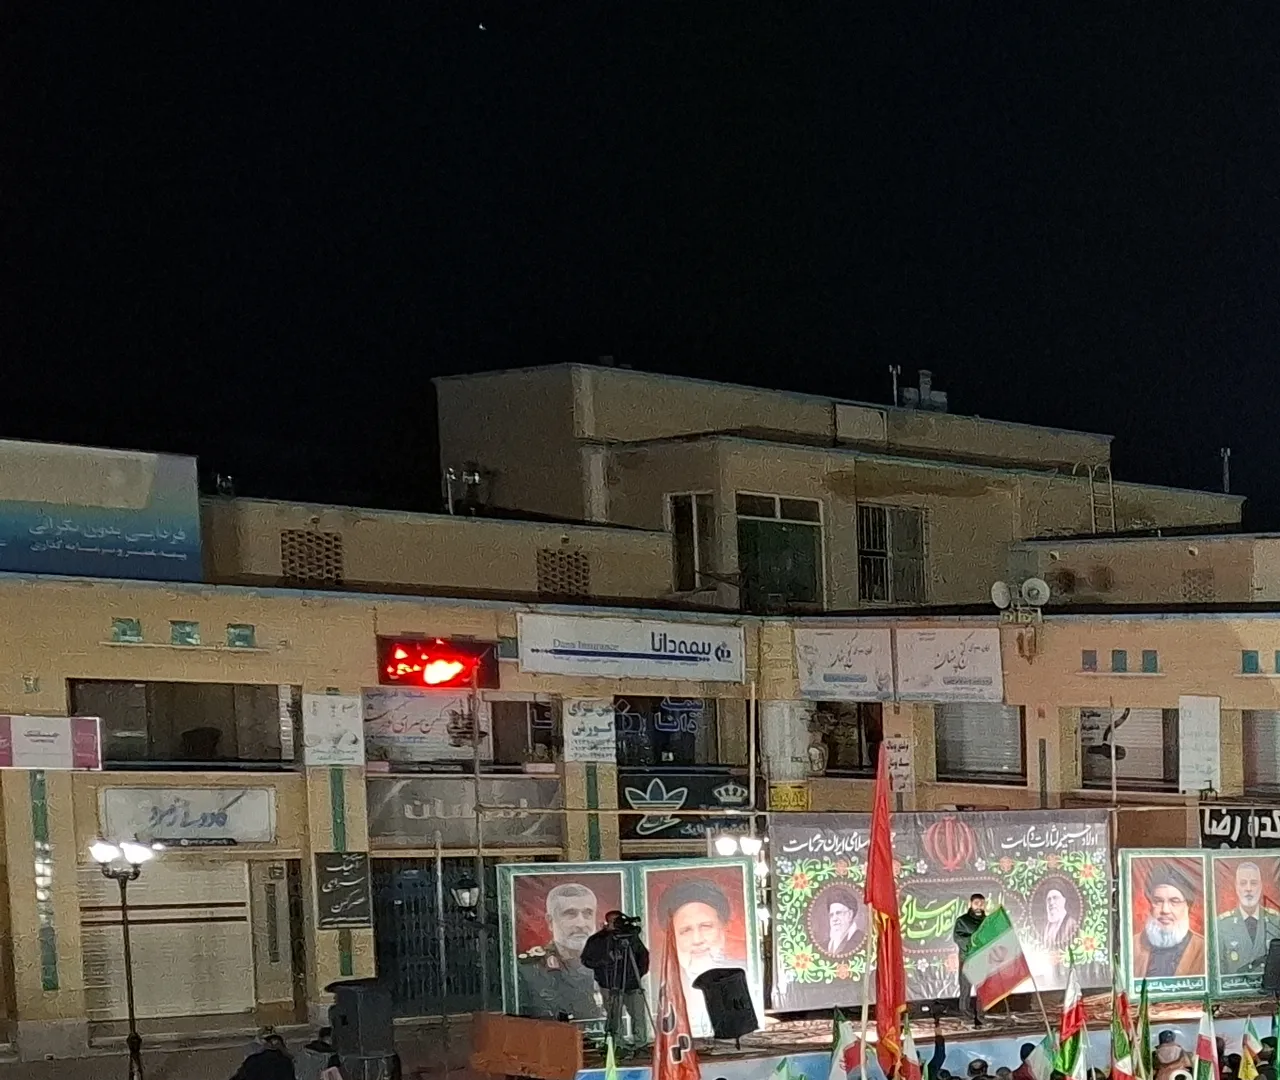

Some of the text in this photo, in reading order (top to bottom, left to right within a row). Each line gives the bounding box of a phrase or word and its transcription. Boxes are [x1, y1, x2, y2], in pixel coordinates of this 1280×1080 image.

[651, 631, 676, 651] دانا
[1204, 808, 1241, 842] رضا
[847, 831, 870, 848] سلامی
